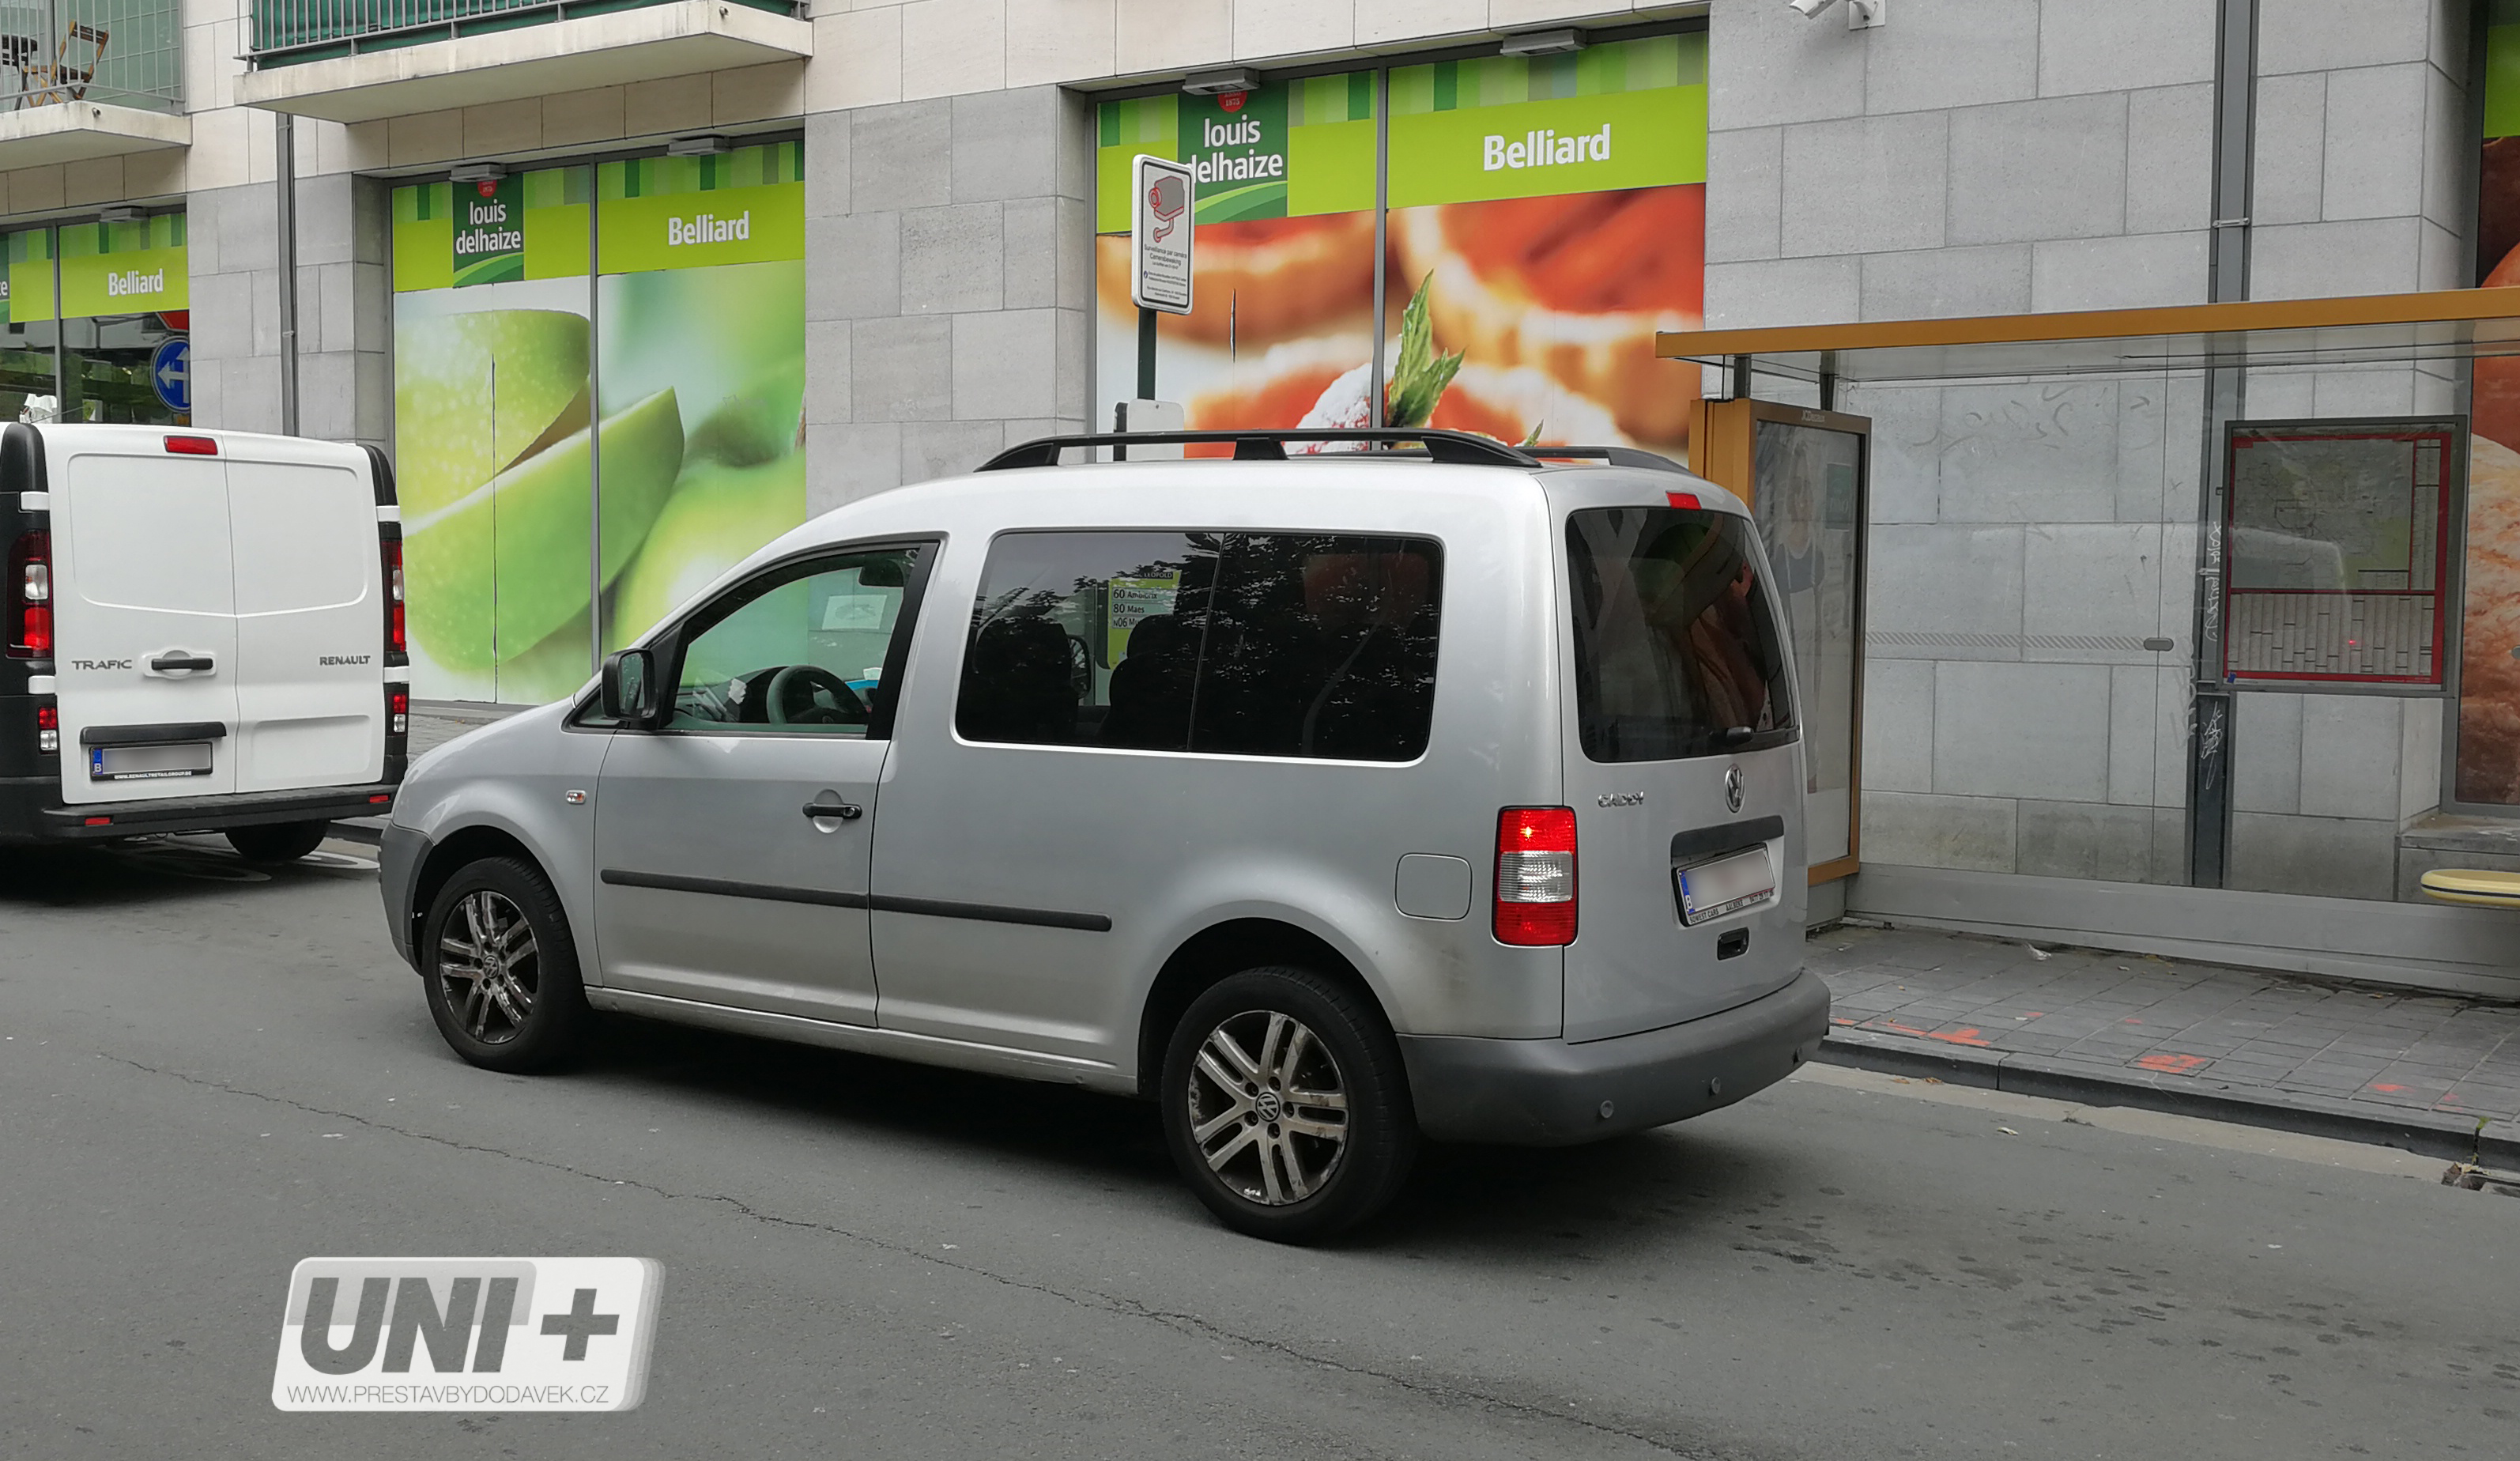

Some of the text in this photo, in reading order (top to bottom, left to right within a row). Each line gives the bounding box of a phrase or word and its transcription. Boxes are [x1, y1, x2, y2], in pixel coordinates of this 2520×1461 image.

[1204, 114, 1261, 149] louis
[1484, 123, 1610, 172] Belliard
[470, 198, 507, 225] louis
[668, 210, 749, 246] Belliard
[455, 226, 522, 254] delhaize
[108, 268, 164, 296] Belliard
[1113, 589, 1126, 598] 60
[1113, 603, 1145, 613] 80 Maes
[1113, 617, 1128, 627] N06
[71, 659, 133, 670] TRAFIC
[319, 655, 371, 666] RENAULT
[94, 763, 102, 772] B
[1684, 894, 1693, 909] B
[1707, 908, 1719, 918] CARS
